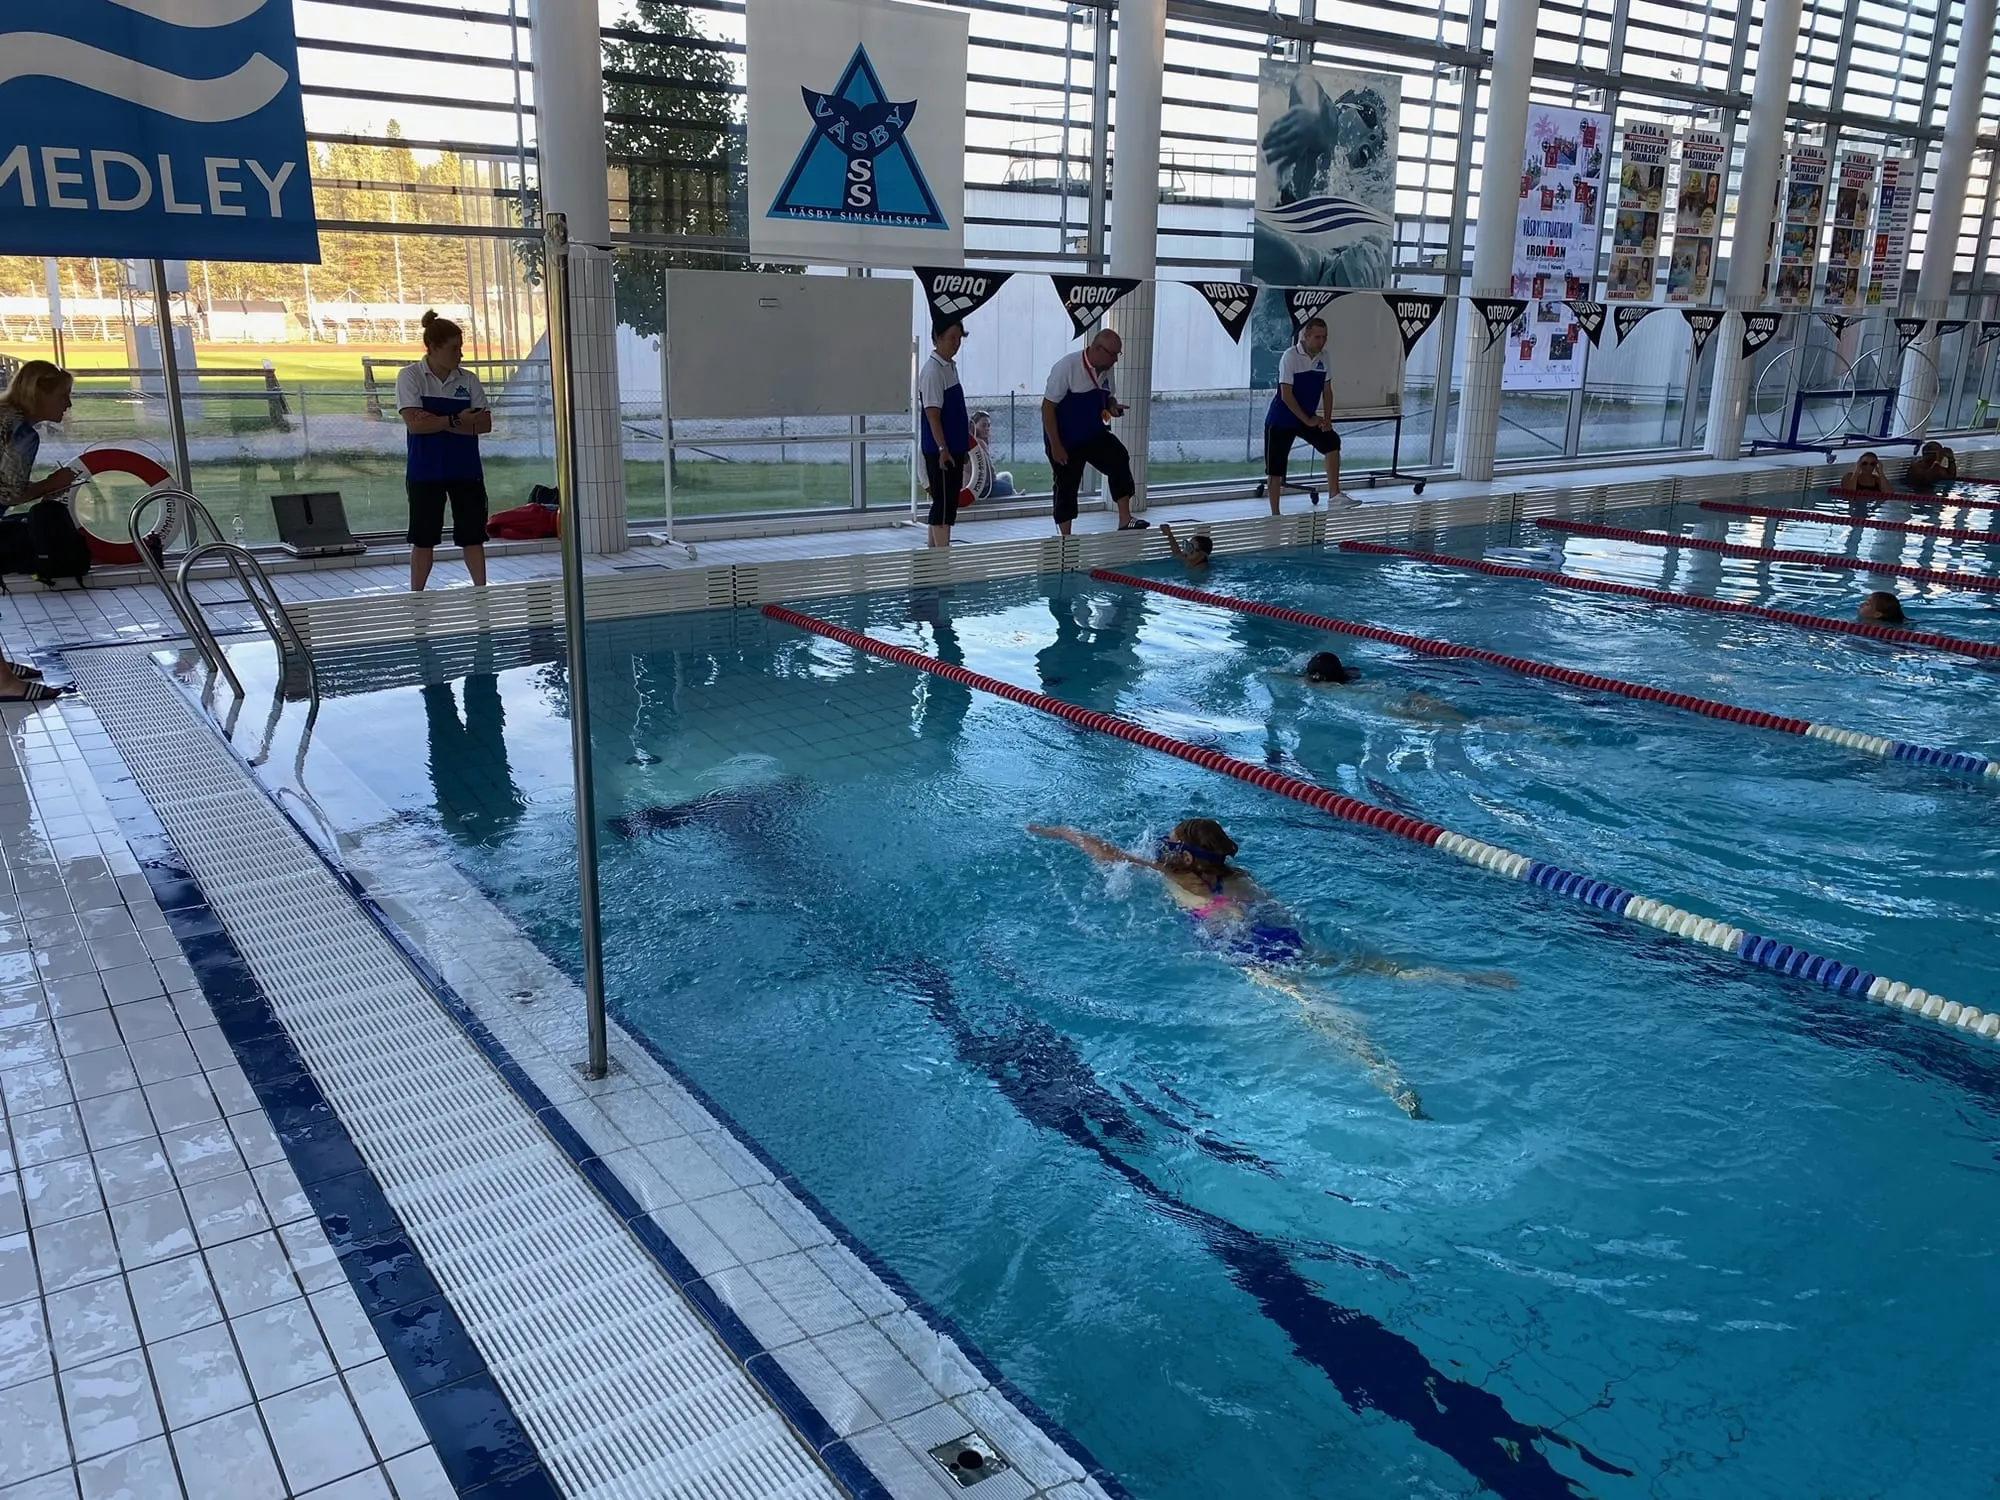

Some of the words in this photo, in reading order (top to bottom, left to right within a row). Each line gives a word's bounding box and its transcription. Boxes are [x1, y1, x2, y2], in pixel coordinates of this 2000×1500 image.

[814, 95, 904, 151] VÄSBY
[789, 207, 833, 219] VÄSBY
[840, 212, 928, 226] SIMSÄLLSKAP
[1526, 240, 1567, 258] IRONMAN
[932, 274, 987, 297] arena
[1203, 282, 1249, 299] arena
[1069, 285, 1118, 304] arena
[1292, 290, 1333, 306] arena
[1397, 302, 1431, 319] arena
[1486, 305, 1515, 321] arena
[1570, 301, 1603, 313] arena
[1619, 307, 1648, 321] arena
[1691, 316, 1713, 329] arena
[1750, 317, 1775, 331] arena
